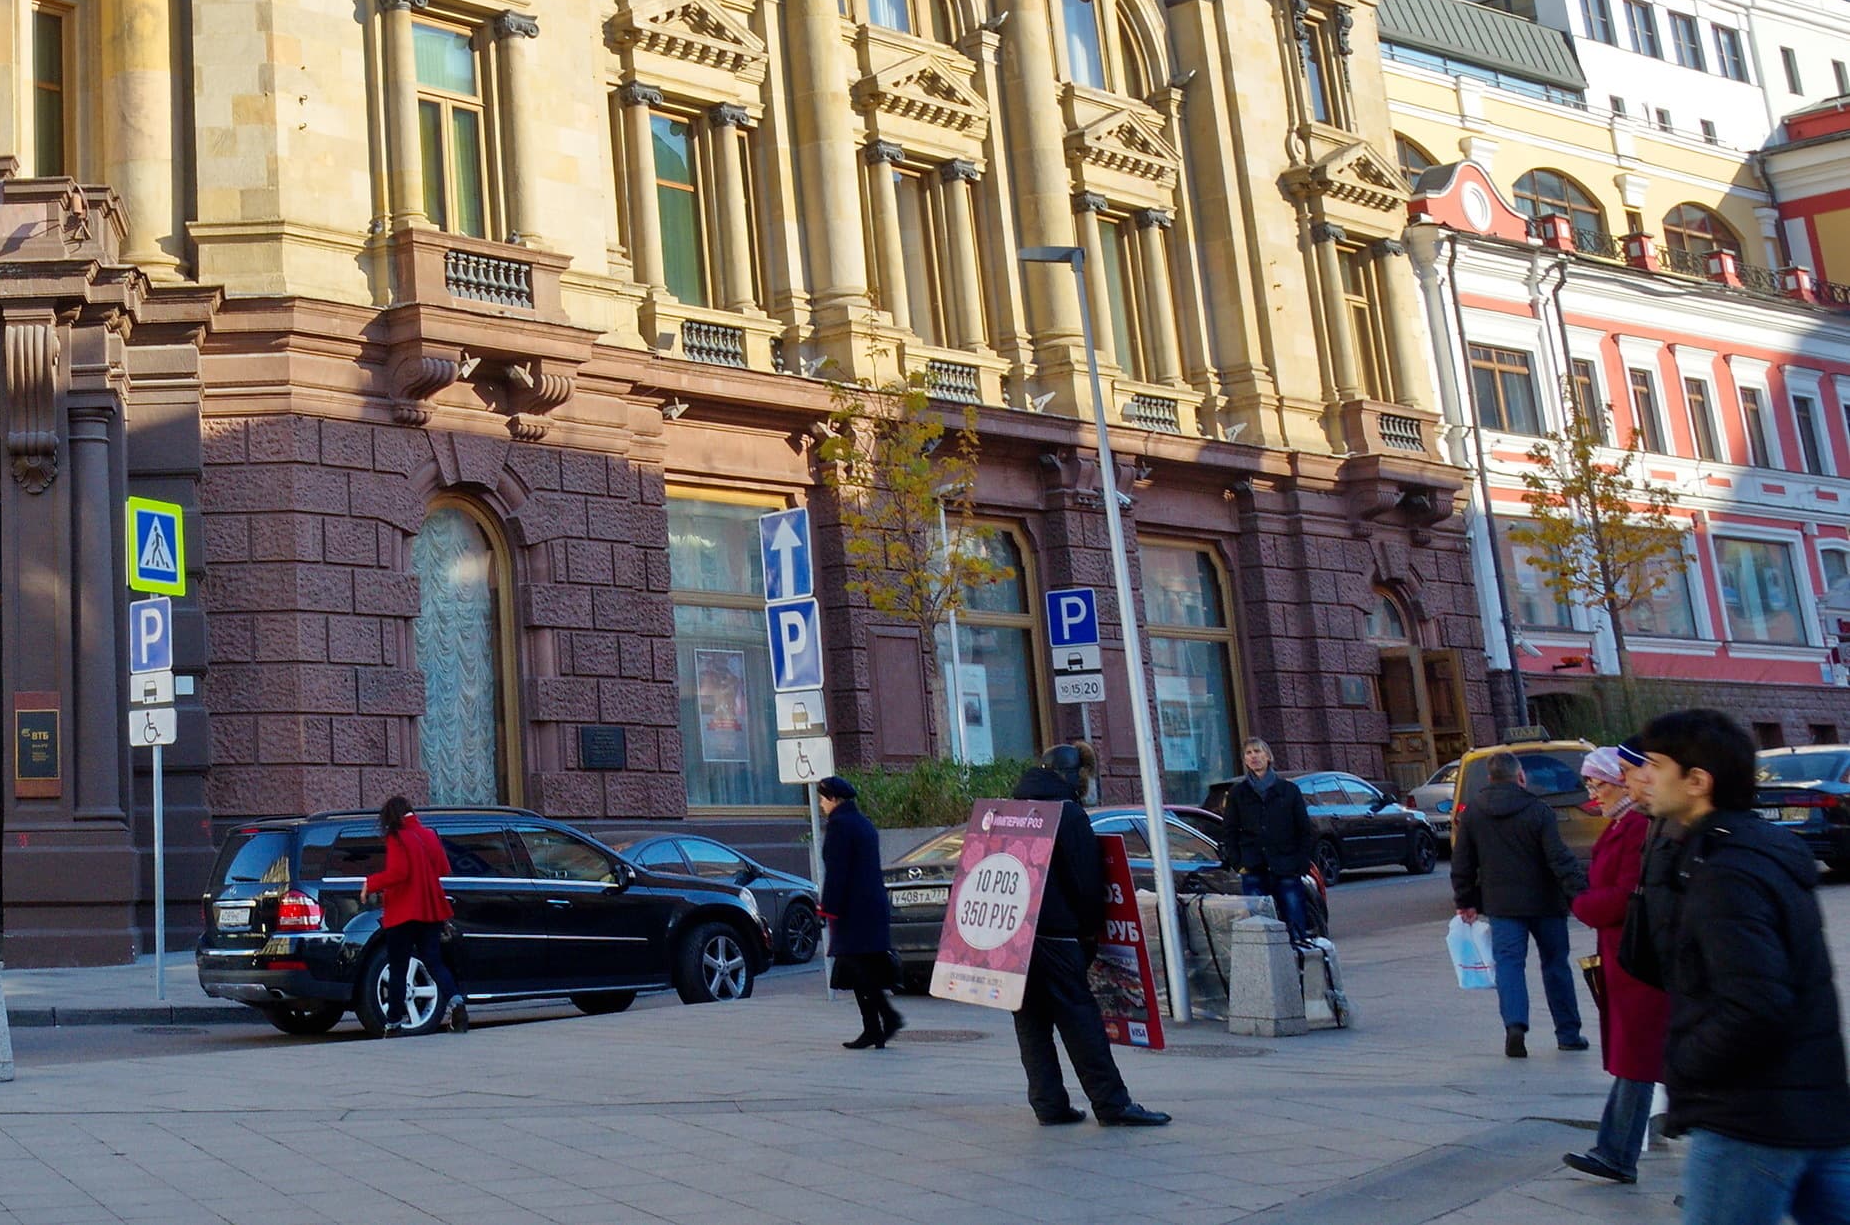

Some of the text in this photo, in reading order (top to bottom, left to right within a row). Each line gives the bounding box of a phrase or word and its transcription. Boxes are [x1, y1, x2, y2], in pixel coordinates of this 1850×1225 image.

[1060, 596, 1087, 640] P
[140, 607, 163, 664] P
[779, 610, 806, 680] P
[1071, 684, 1081, 694] 15
[1084, 682, 1099, 694] 20
[31, 731, 49, 741] ВТБ
[1027, 817, 1044, 829] РОЗ
[975, 868, 1019, 896] 10 РОЗ
[961, 900, 1019, 931] 350 РУБ
[1107, 920, 1140, 943] РУБ
[1131, 1027, 1147, 1039] VISA
